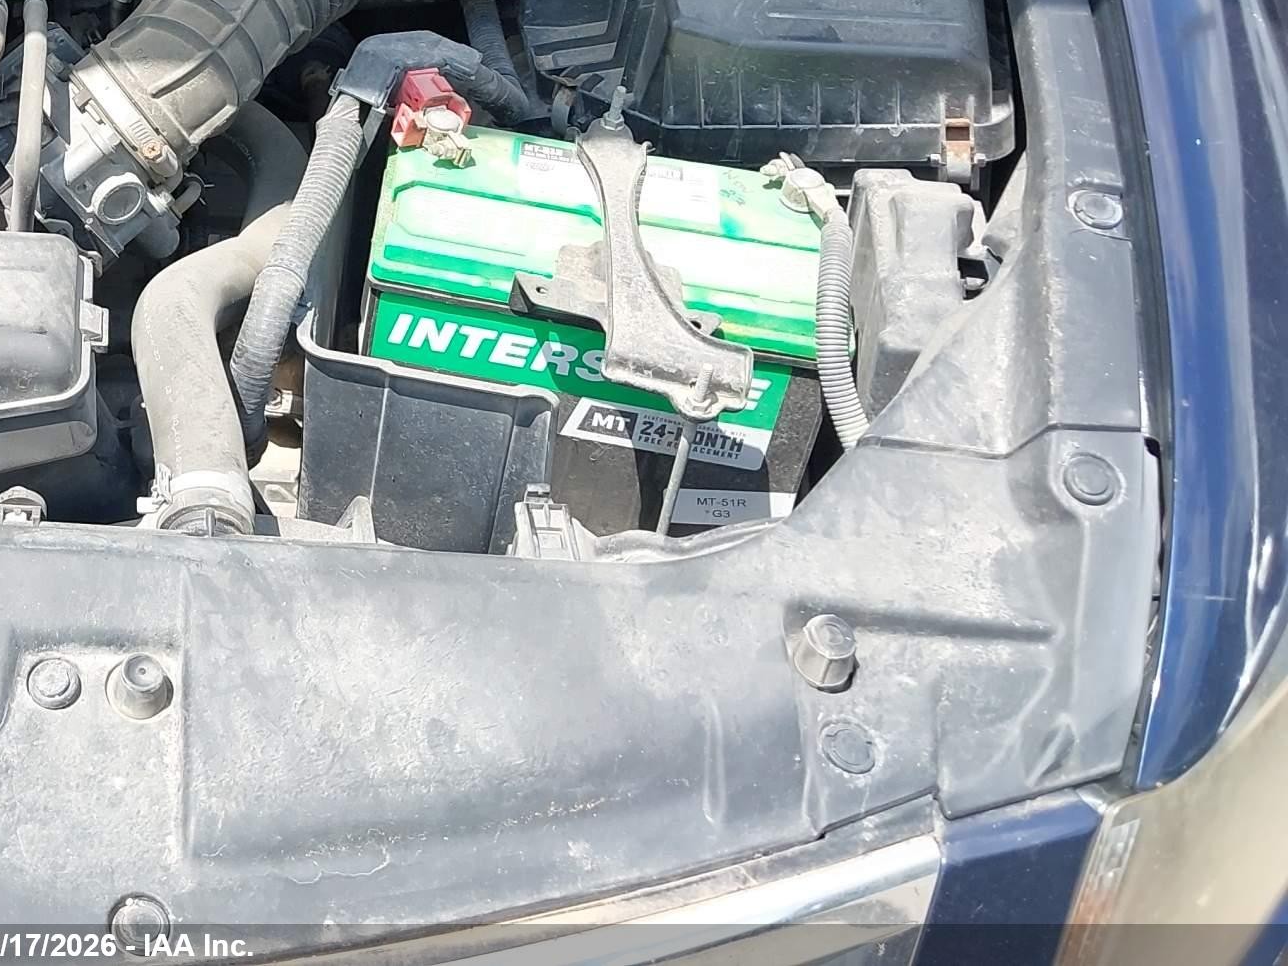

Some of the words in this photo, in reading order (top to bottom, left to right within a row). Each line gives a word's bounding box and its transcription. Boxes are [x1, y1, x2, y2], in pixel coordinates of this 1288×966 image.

[387, 312, 772, 411] INTERS
[591, 412, 631, 432] MT
[666, 440, 741, 460] REACEMENT
[696, 497, 747, 507] MT-51R
